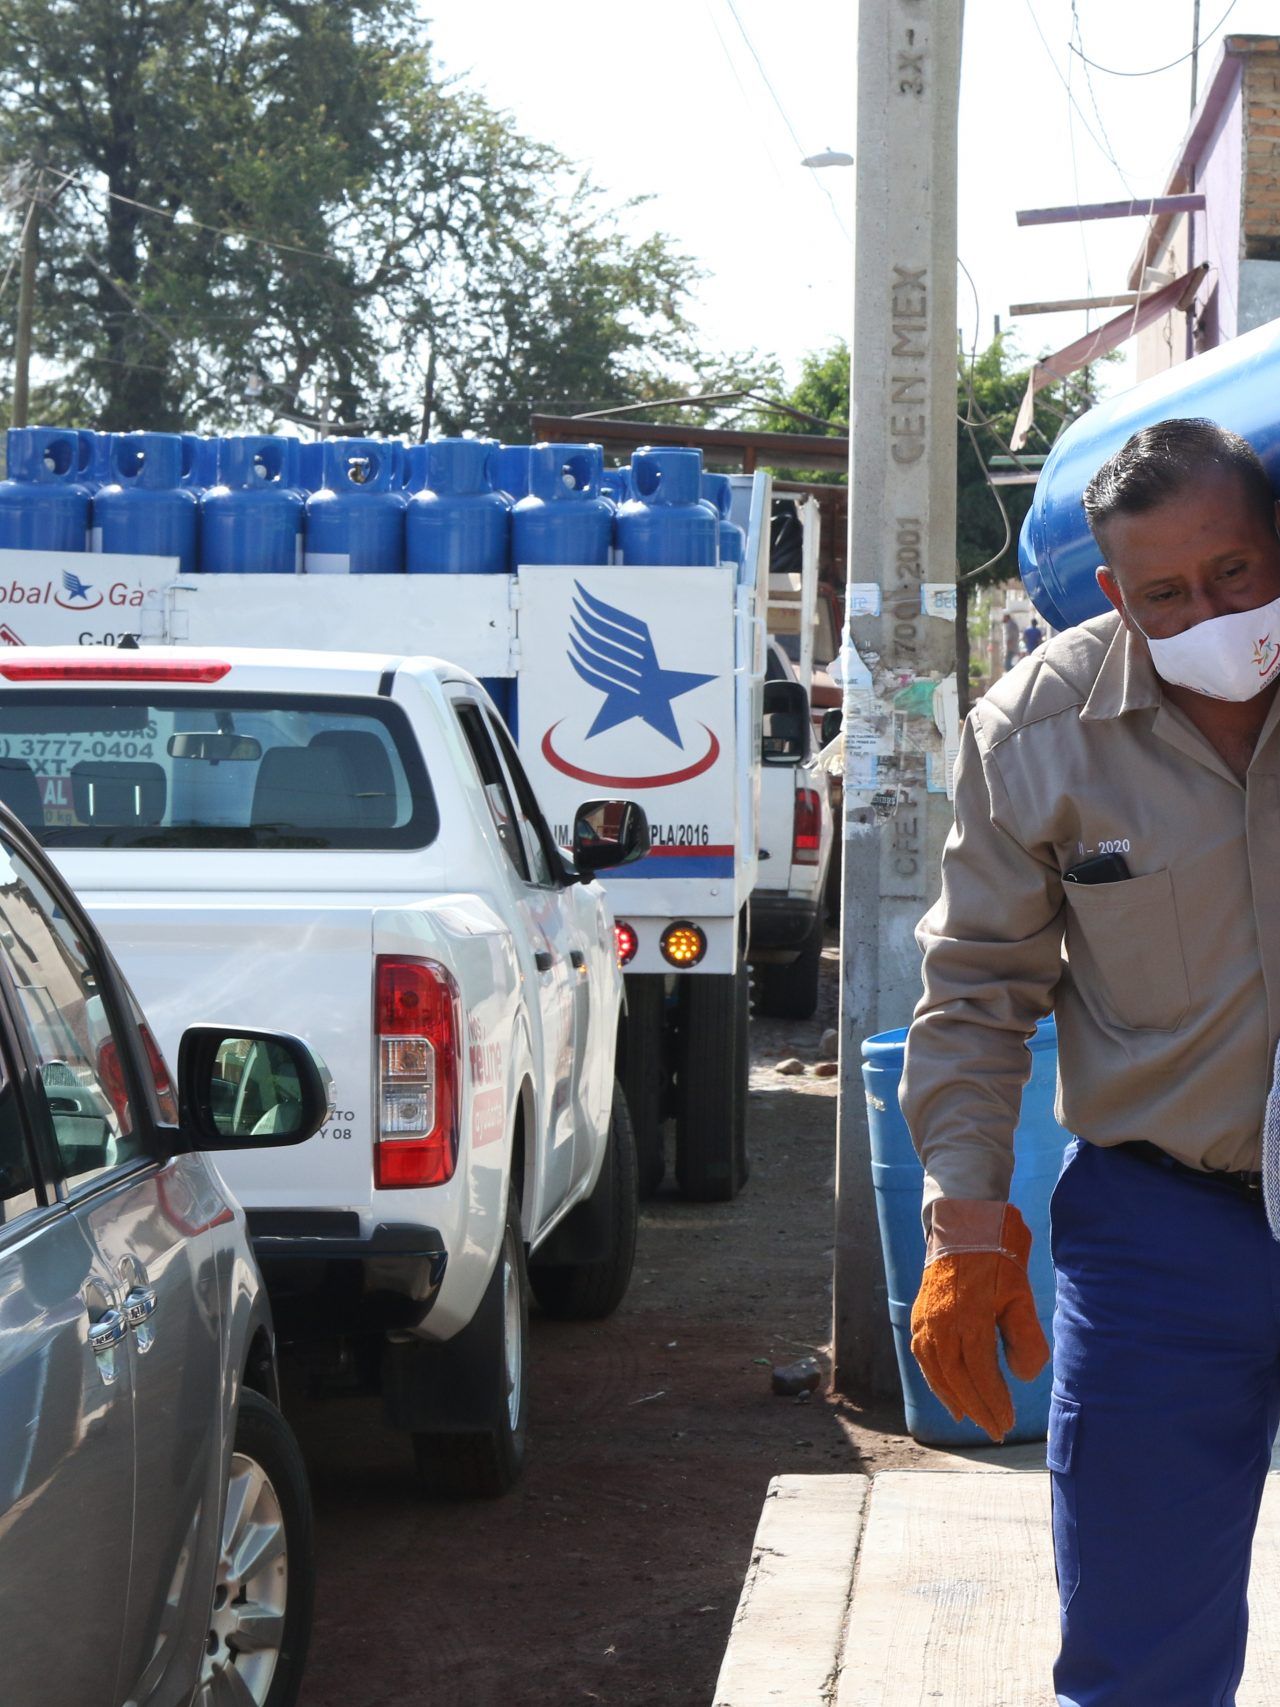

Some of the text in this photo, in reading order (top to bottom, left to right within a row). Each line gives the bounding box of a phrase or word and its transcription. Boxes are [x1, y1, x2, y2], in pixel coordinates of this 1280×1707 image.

[890, 264, 928, 465] CEN MEX
[895, 517, 921, 580] 2001
[20, 738, 154, 760] 3777-0404
[650, 824, 709, 846] PLA/2016
[1098, 838, 1130, 854] 2020
[332, 1128, 352, 1139] 08
